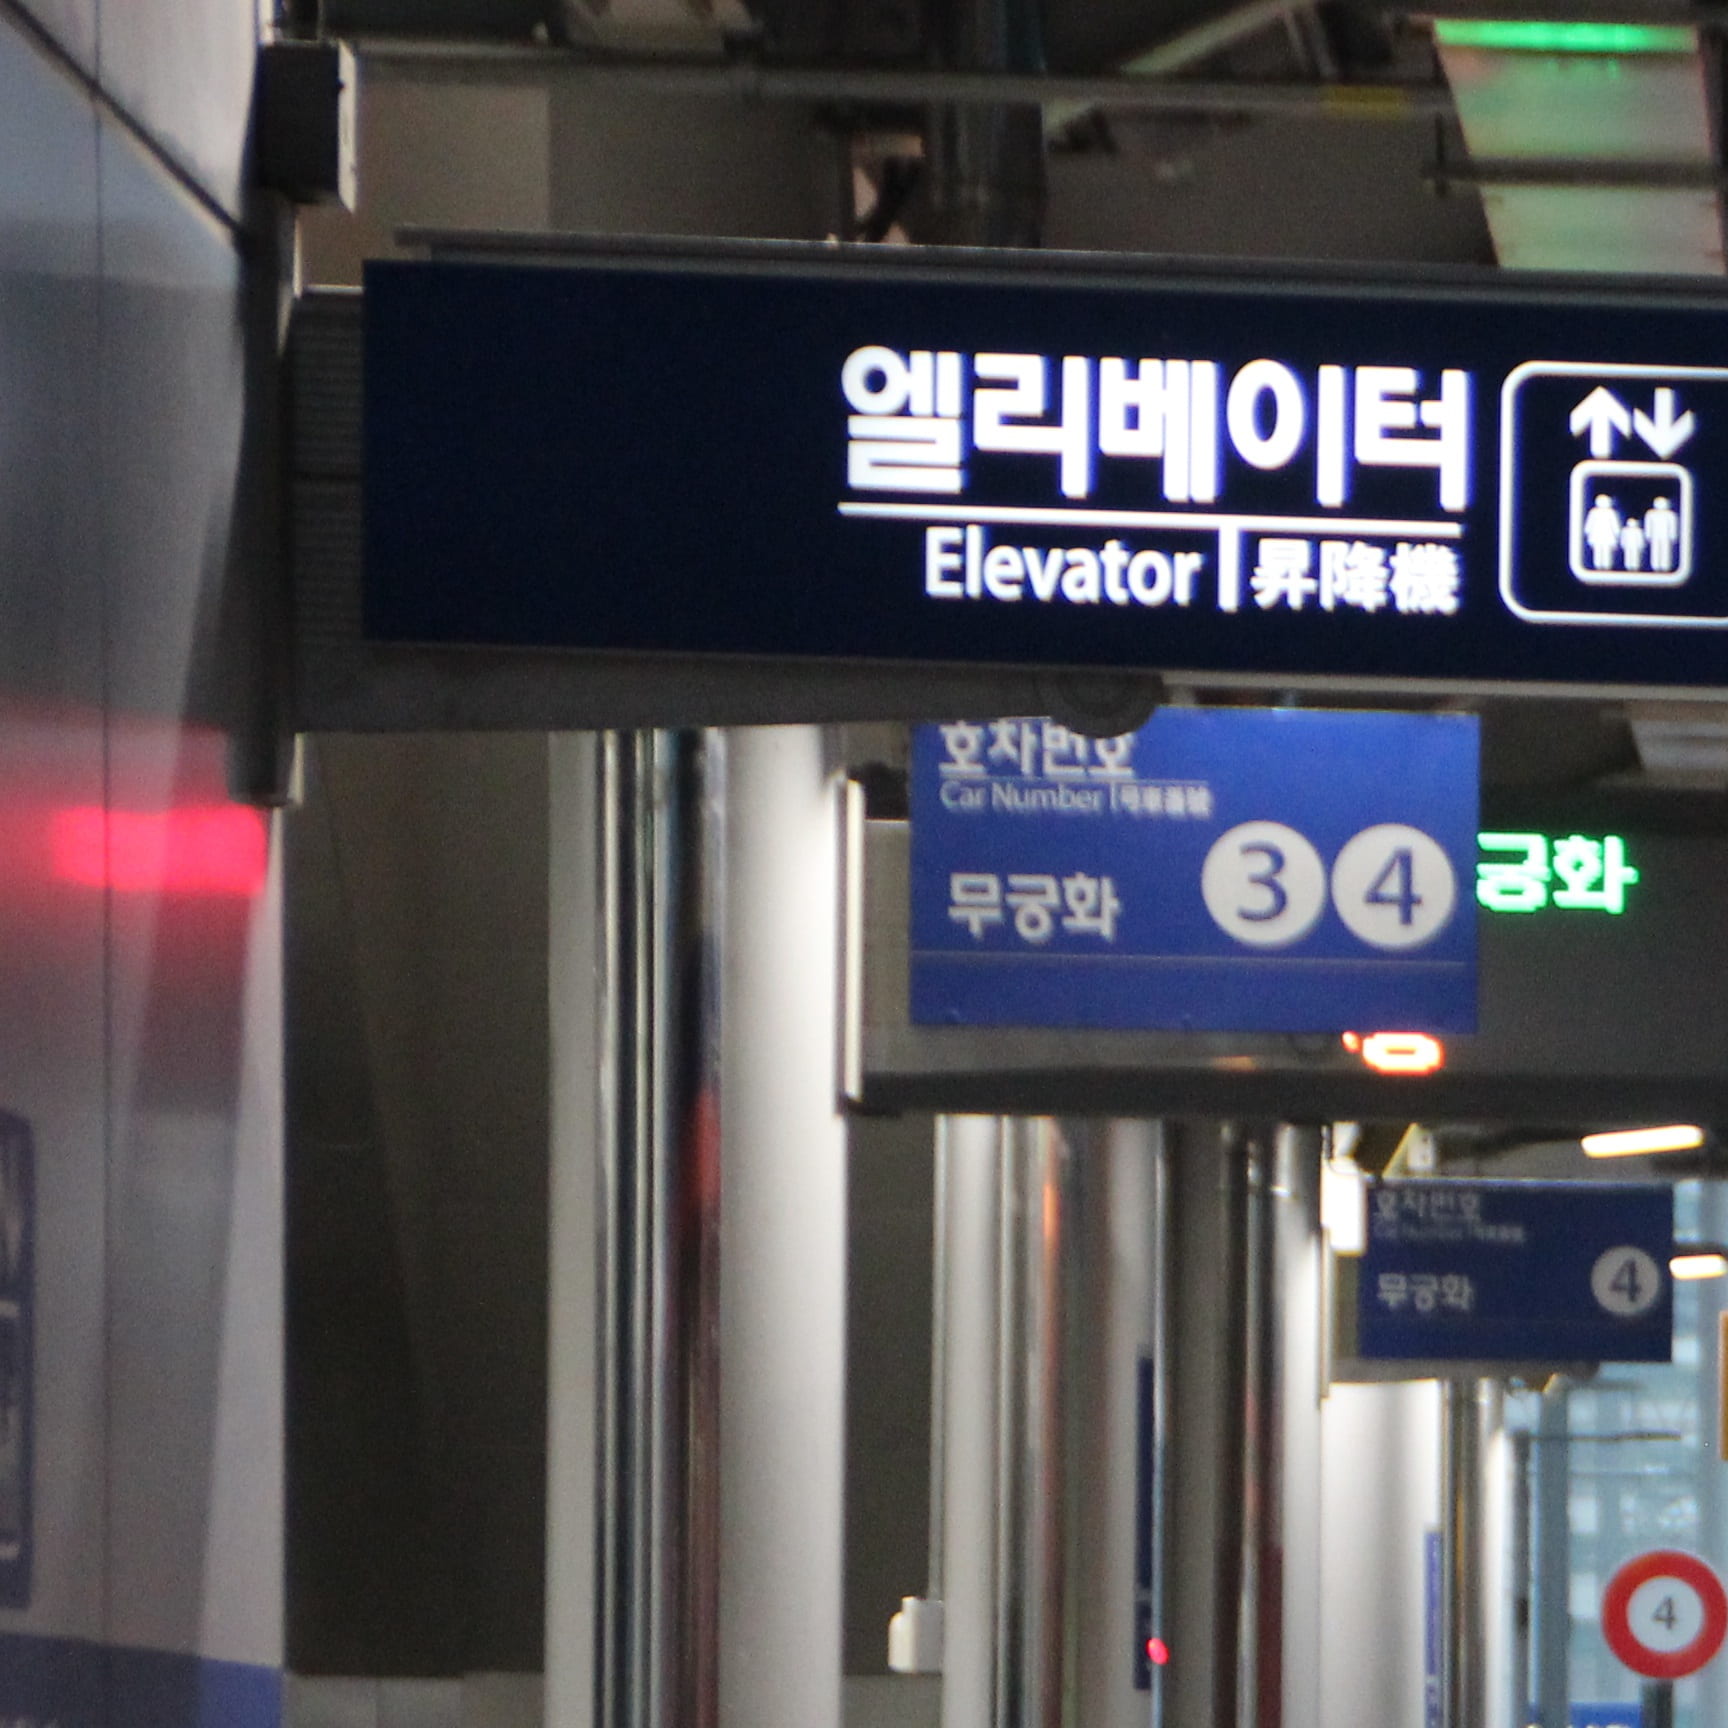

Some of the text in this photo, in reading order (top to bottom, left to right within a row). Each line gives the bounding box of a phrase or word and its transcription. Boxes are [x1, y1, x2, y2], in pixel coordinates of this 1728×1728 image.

[841, 345, 1471, 513] 엘리베이터
[925, 525, 1203, 606] Elevator
[1250, 537, 1461, 614] 昇降機
[940, 781, 986, 810] Car
[992, 781, 1102, 813] Number
[949, 841, 1423, 943] 무궁화 3 4
[1651, 1595, 1678, 1631] 4
